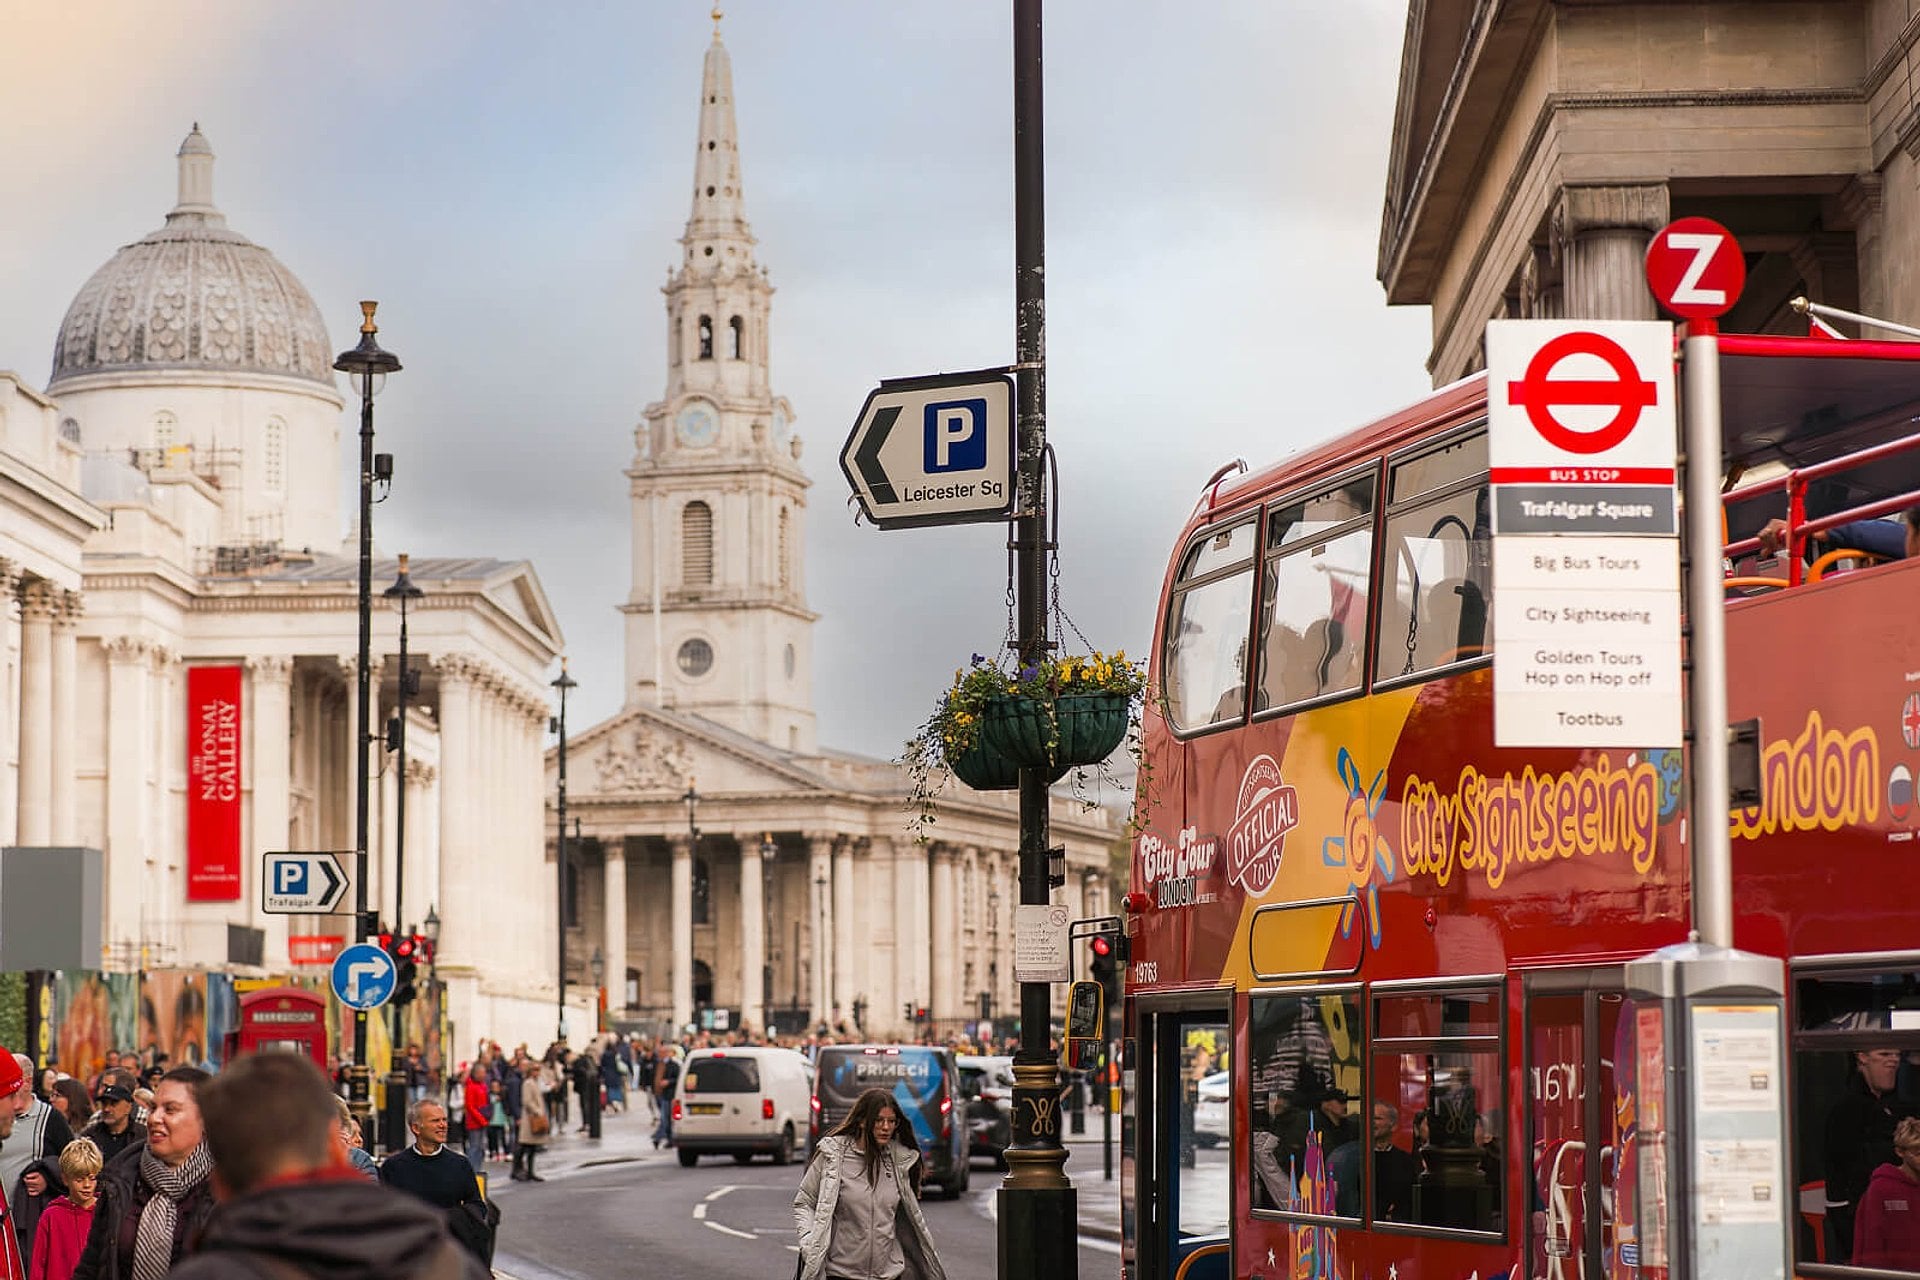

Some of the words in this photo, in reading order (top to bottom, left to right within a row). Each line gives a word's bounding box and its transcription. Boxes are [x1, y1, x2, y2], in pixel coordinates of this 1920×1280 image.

[1667, 233, 1727, 306] Z
[936, 406, 974, 467] P
[1550, 470, 1579, 481] BUS
[1583, 470, 1620, 481] STOP
[904, 482, 976, 503] Leicester
[981, 480, 1003, 498] Sq
[1520, 501, 1594, 519] Trafalgar
[1597, 501, 1654, 519] Square
[1534, 556, 1557, 572] Big
[1563, 556, 1591, 569] Bus
[1598, 556, 1640, 569] Tours
[1526, 607, 1557, 624] City
[1563, 607, 1652, 624] Sightseeing
[1535, 650, 1594, 664] Golden
[1599, 651, 1643, 664] Tours
[1525, 672, 1558, 685] Hop
[1564, 674, 1585, 683] on
[1590, 672, 1623, 685] Hop
[1628, 672, 1652, 685] off
[1557, 712, 1623, 726] Tootbus
[202, 699, 218, 800] NATIONAL
[218, 699, 237, 802] GALLERY
[1234, 791, 1296, 869] OFFICIAL
[1401, 774, 1460, 887] City
[1459, 754, 1659, 889] Sightseeing
[1140, 833, 1175, 883] City
[1176, 825, 1215, 878] Tour
[1252, 844, 1281, 886] TOUR
[280, 863, 304, 893] P
[269, 897, 314, 908] Trafalgar
[1158, 875, 1197, 909] LONDON
[1135, 962, 1158, 984] 19763
[856, 1061, 930, 1077] PRIMECH
